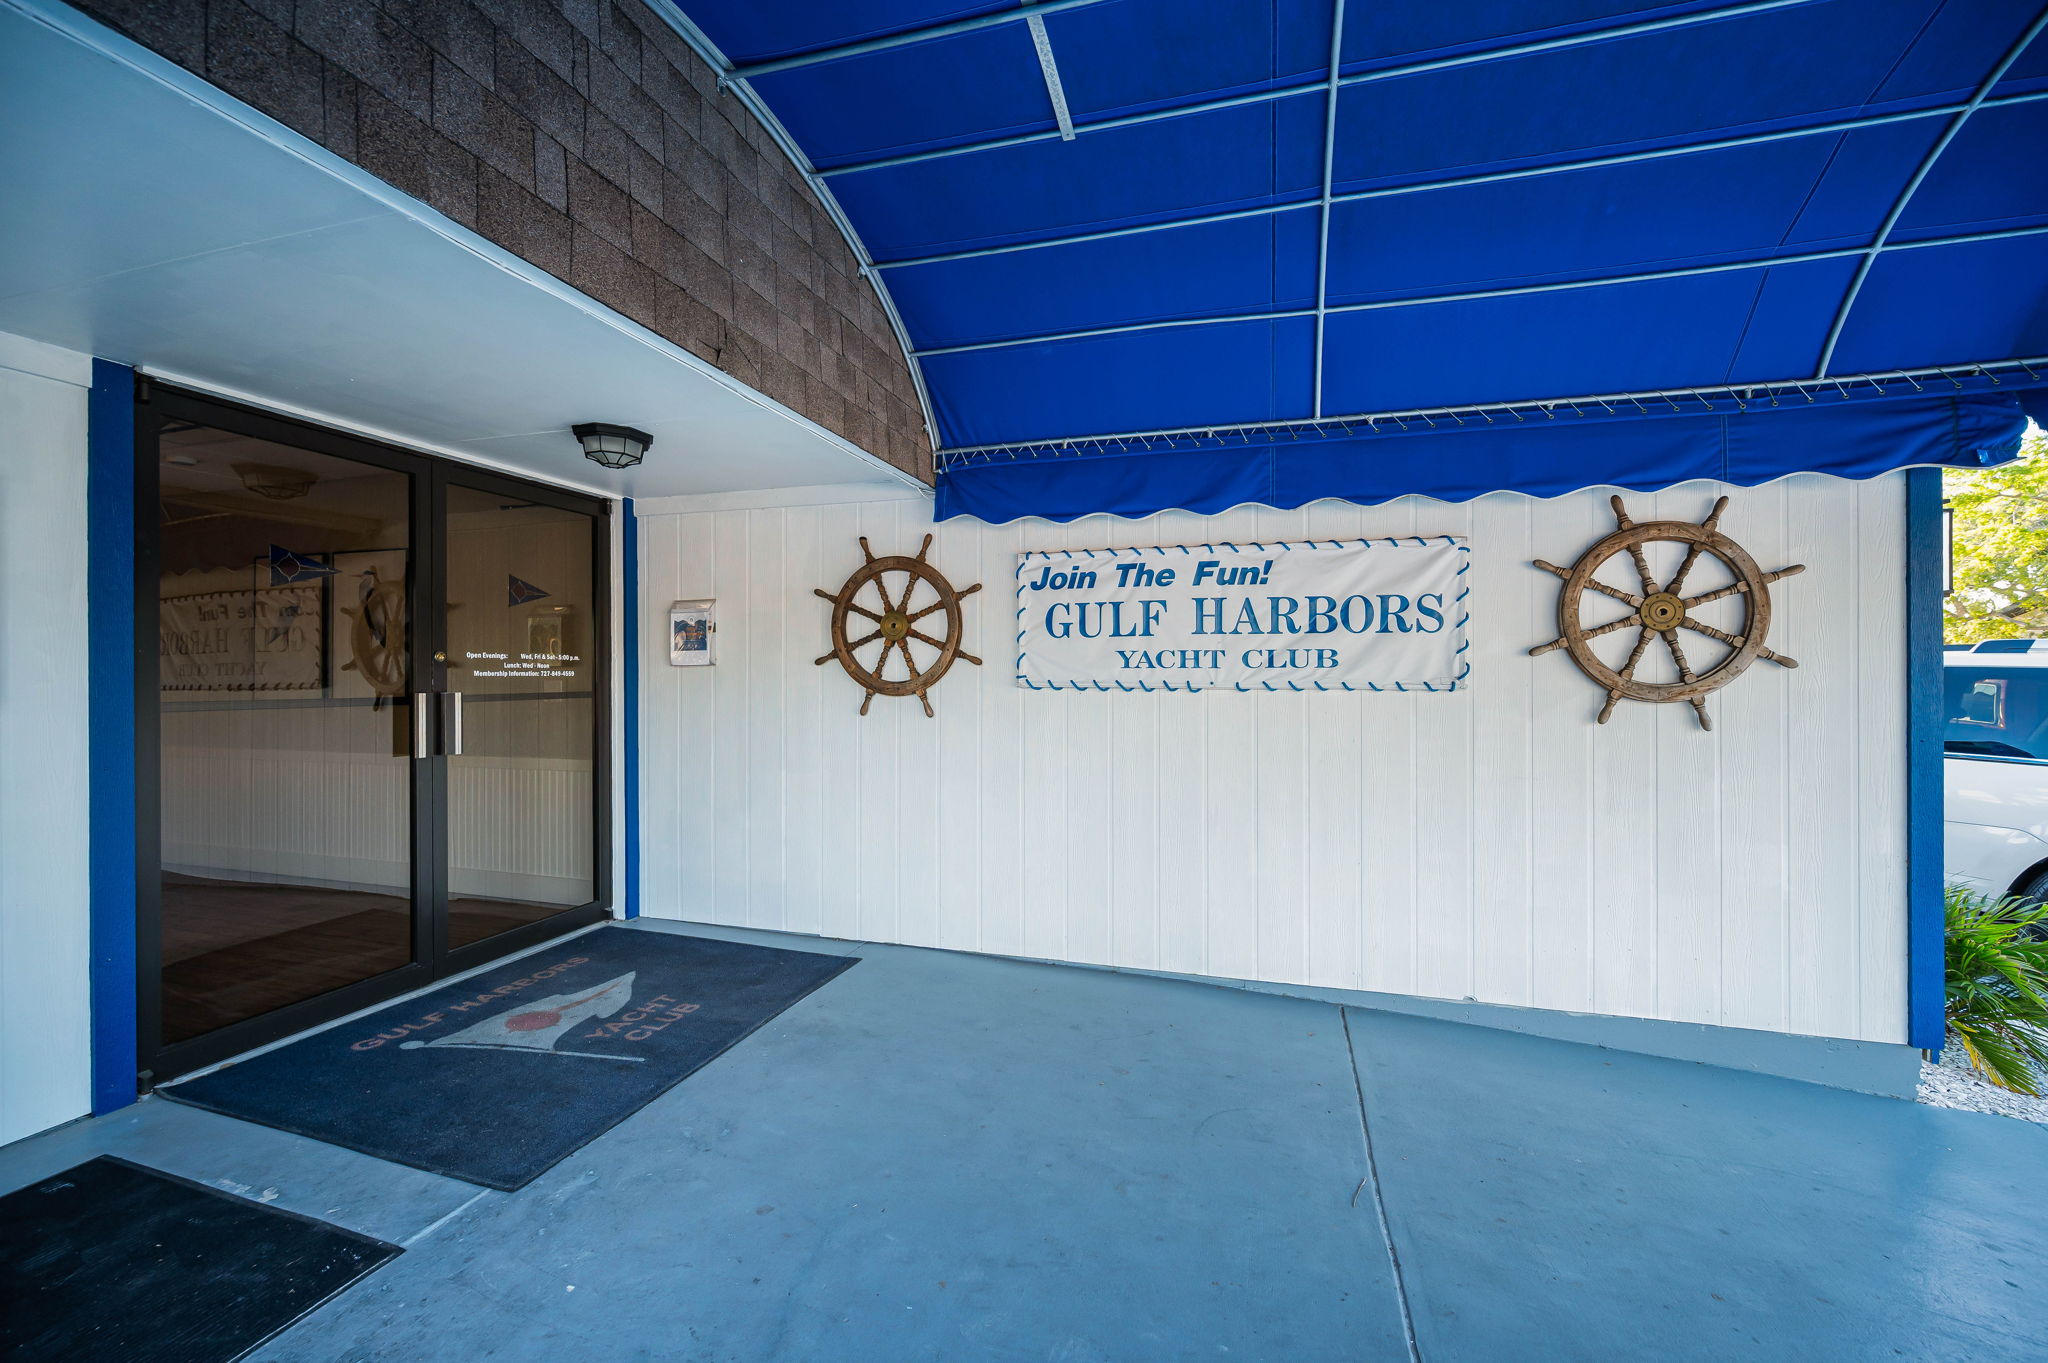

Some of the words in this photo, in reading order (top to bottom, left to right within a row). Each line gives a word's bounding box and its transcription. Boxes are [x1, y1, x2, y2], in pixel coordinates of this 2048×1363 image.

[1030, 565, 1097, 591] Join
[1115, 562, 1176, 589] The
[1192, 559, 1273, 586] Fun!
[1045, 599, 1168, 639] GULF
[1191, 593, 1445, 635] HARBORS
[466, 651, 481, 660] Open
[482, 652, 508, 660] Evenings:
[1116, 650, 1226, 669] YACHT
[1242, 648, 1340, 669] CLUB
[473, 670, 508, 678] Membership
[350, 1011, 447, 1051] GULF
[450, 955, 590, 1012] HARBORS
[584, 994, 678, 1040] YACHT
[623, 1003, 702, 1042] CLUB
